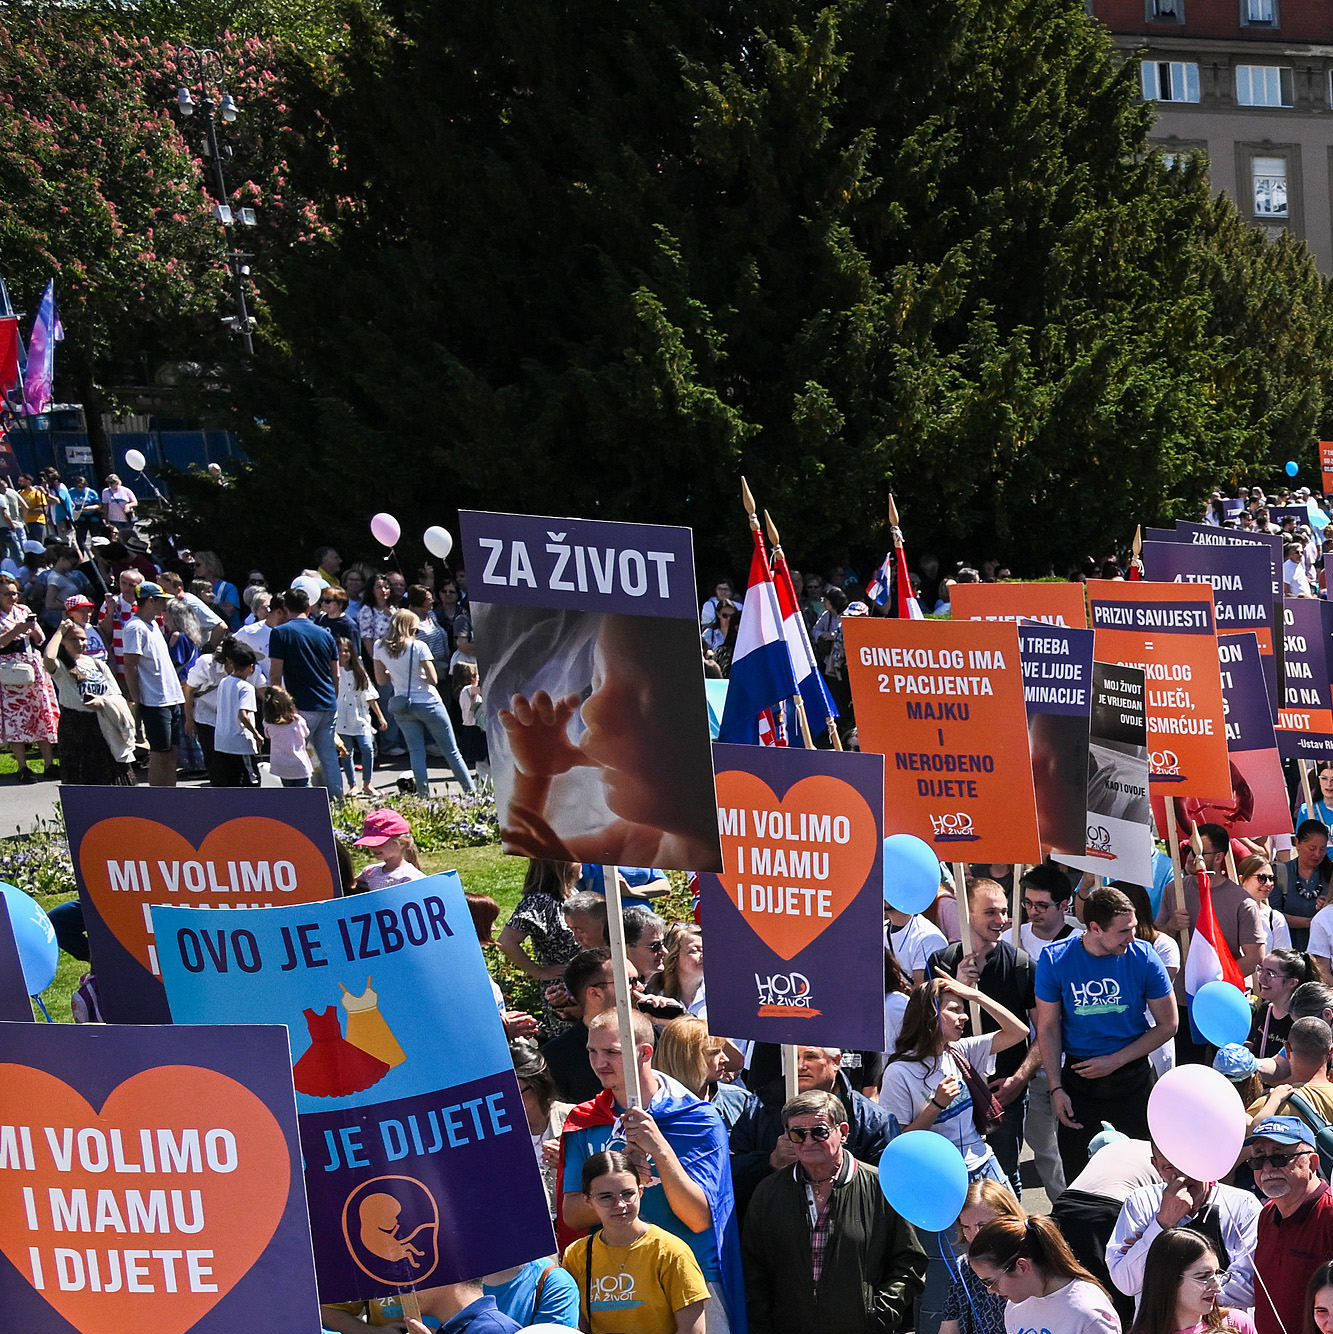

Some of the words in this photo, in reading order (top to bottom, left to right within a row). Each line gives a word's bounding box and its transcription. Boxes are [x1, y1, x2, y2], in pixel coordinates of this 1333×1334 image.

[478, 537, 537, 590] ZA
[548, 532, 675, 598] ŽIVOT
[1094, 606, 1134, 624] PRIZIV
[1136, 608, 1207, 627] SAVIJESTI
[1239, 603, 1267, 621] IMA
[1026, 638, 1070, 655] TREBA
[859, 647, 964, 669] GINEKOLOG
[968, 651, 1006, 670] IMA
[1041, 663, 1083, 681] LJUDE
[878, 675, 889, 693] 2
[894, 675, 994, 696] PACIJENTA
[1103, 679, 1119, 693] MOJ
[1120, 680, 1142, 695] ŽIVOT
[1107, 696, 1143, 712] VRIJEDAN
[1150, 690, 1195, 710] LIJEČI,
[1299, 689, 1321, 705] NA
[906, 701, 970, 721] MAJKU
[1120, 713, 1143, 727] OVDJE
[1297, 739, 1323, 750] -Ustav
[895, 752, 994, 773] NEROĐENO
[917, 778, 978, 798] DIJETE
[1125, 783, 1146, 797] OVDJE
[718, 807, 745, 837] MI
[753, 807, 851, 843] VOLIMO
[929, 812, 973, 831] HOD
[751, 847, 830, 880] MAMU
[106, 860, 152, 891] MI
[157, 860, 297, 892] VOLIMO
[751, 883, 833, 918] DIJETE
[177, 927, 261, 974] OVO
[280, 921, 330, 972] JE
[341, 897, 454, 962] IZBOR
[755, 972, 811, 998] HOD
[1070, 979, 1120, 1000] HOD
[758, 994, 777, 1006] ZA
[779, 993, 813, 1008] ŽIVOT
[323, 1126, 370, 1172] JE
[379, 1094, 513, 1163] DIJETE
[44, 1128, 238, 1172] VOLIMO
[22, 1186, 38, 1230] I
[50, 1187, 205, 1233] MAMU
[28, 1247, 45, 1290] I
[54, 1248, 219, 1293] DIJETE
